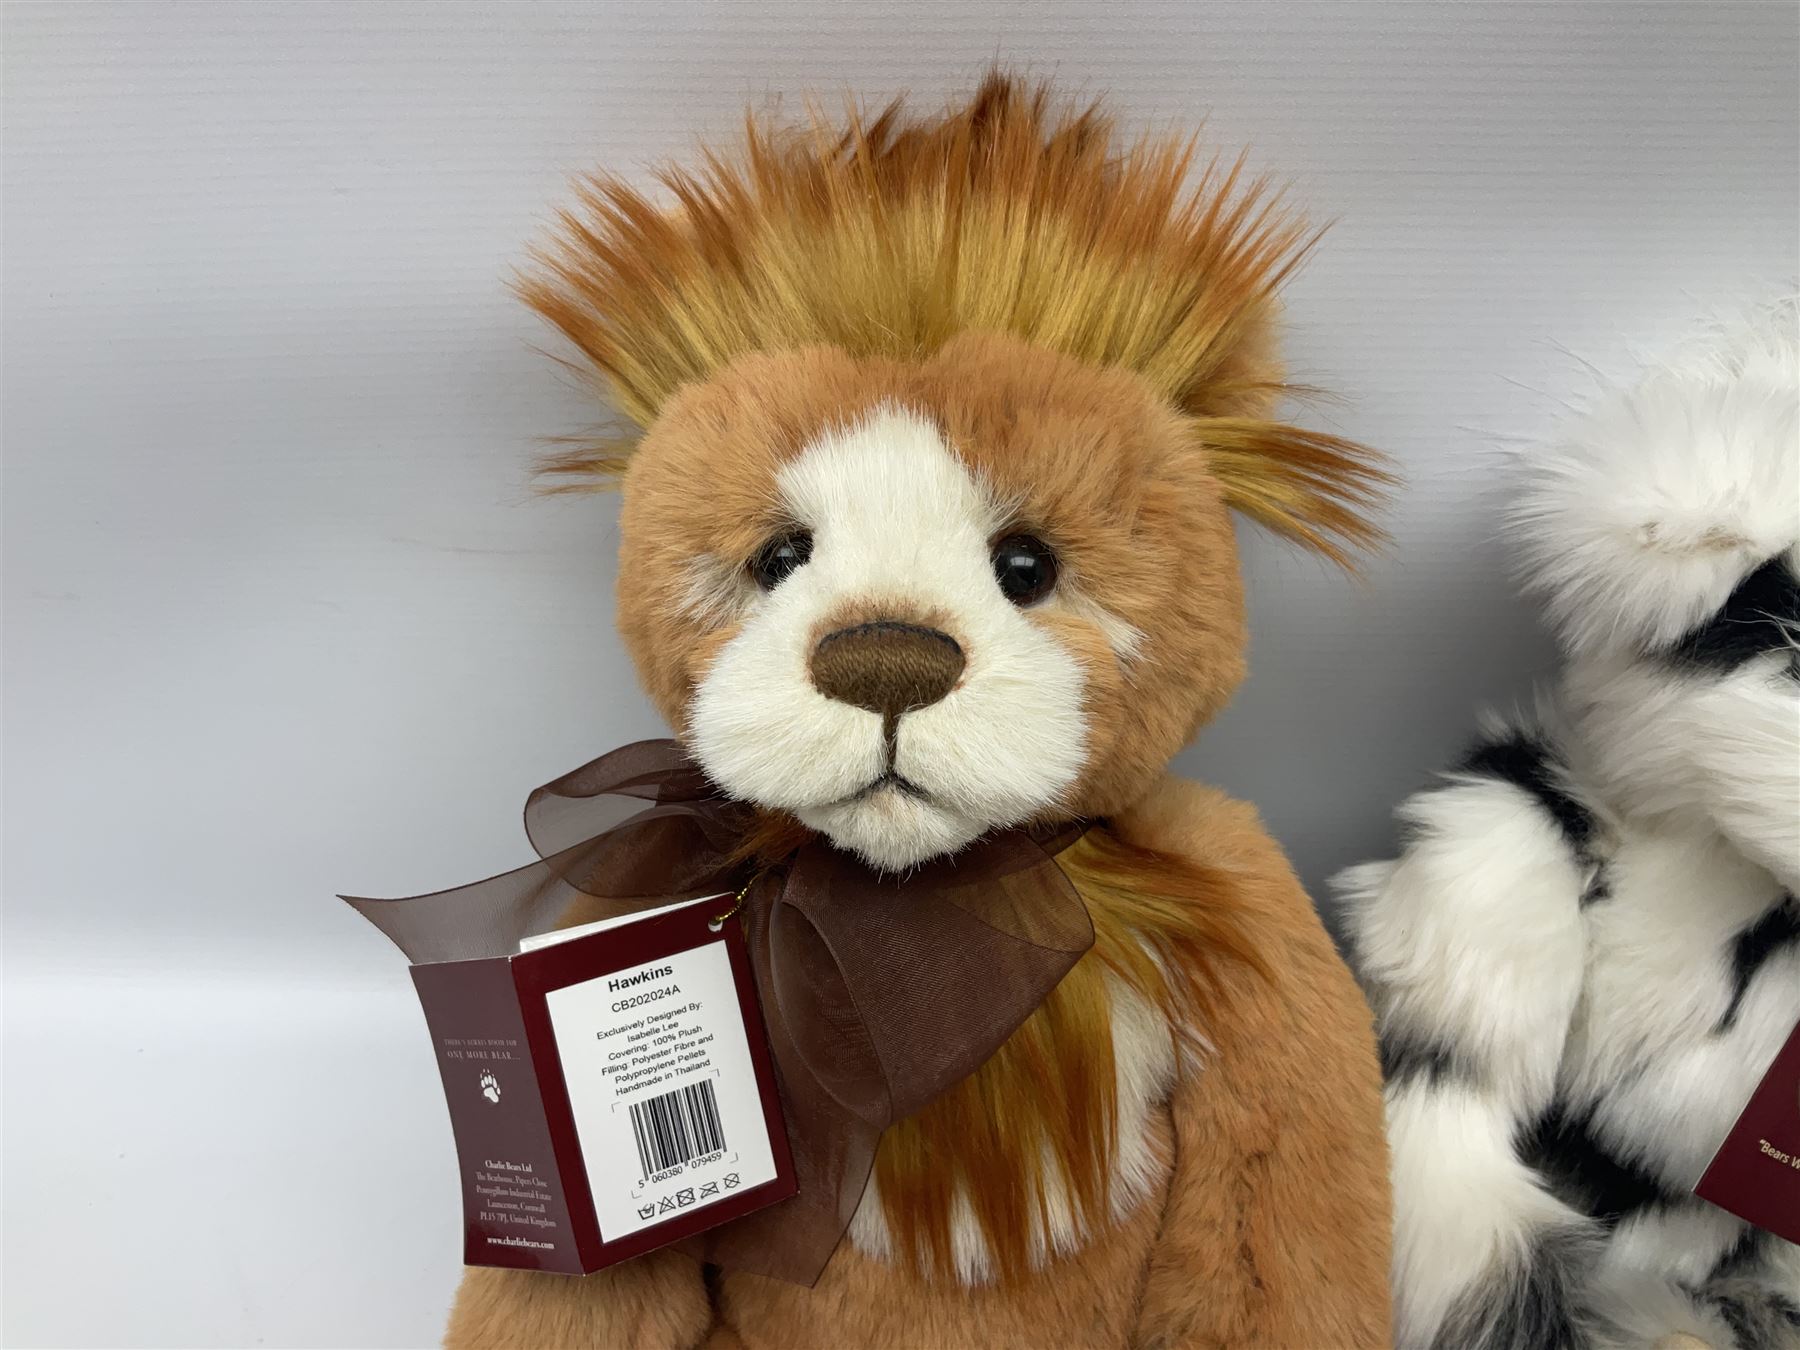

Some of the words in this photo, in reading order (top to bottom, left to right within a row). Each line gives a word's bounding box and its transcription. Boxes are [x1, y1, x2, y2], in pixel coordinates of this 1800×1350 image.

[608, 965, 674, 992] Hawkins
[611, 984, 681, 1013] CB202024A
[596, 1019, 645, 1040] Exclusively
[646, 1006, 687, 1024] Designed
[689, 1001, 703, 1012] By:
[627, 1027, 660, 1043] Isabelle
[662, 1021, 679, 1032] Lee
[447, 1050, 463, 1058] ONE
[466, 1050, 489, 1059] MORE
[601, 1061, 630, 1076] Filling:
[632, 1047, 672, 1066] Polyester
[674, 1041, 696, 1053] Fibre
[698, 1034, 714, 1045] and
[608, 1042, 650, 1061] Covering:
[652, 1033, 676, 1047] 100%
[678, 1025, 702, 1039] Plush
[615, 1059, 676, 1084] Polypropylene
[677, 1049, 706, 1064] Pellets
[615, 1075, 663, 1096] Handmade
[665, 1072, 673, 1080] in
[675, 1059, 711, 1076] Thailand
[485, 1160, 505, 1169] Charlie
[506, 1162, 522, 1171] Bears
[522, 1163, 532, 1173] Ltd
[638, 1179, 645, 1189] 5
[652, 1166, 683, 1184] 060380
[691, 1152, 722, 1169] 079459
[509, 1213, 530, 1224] United
[530, 1215, 557, 1228] Kingdom
[487, 1235, 555, 1250] www.charliebears.com
